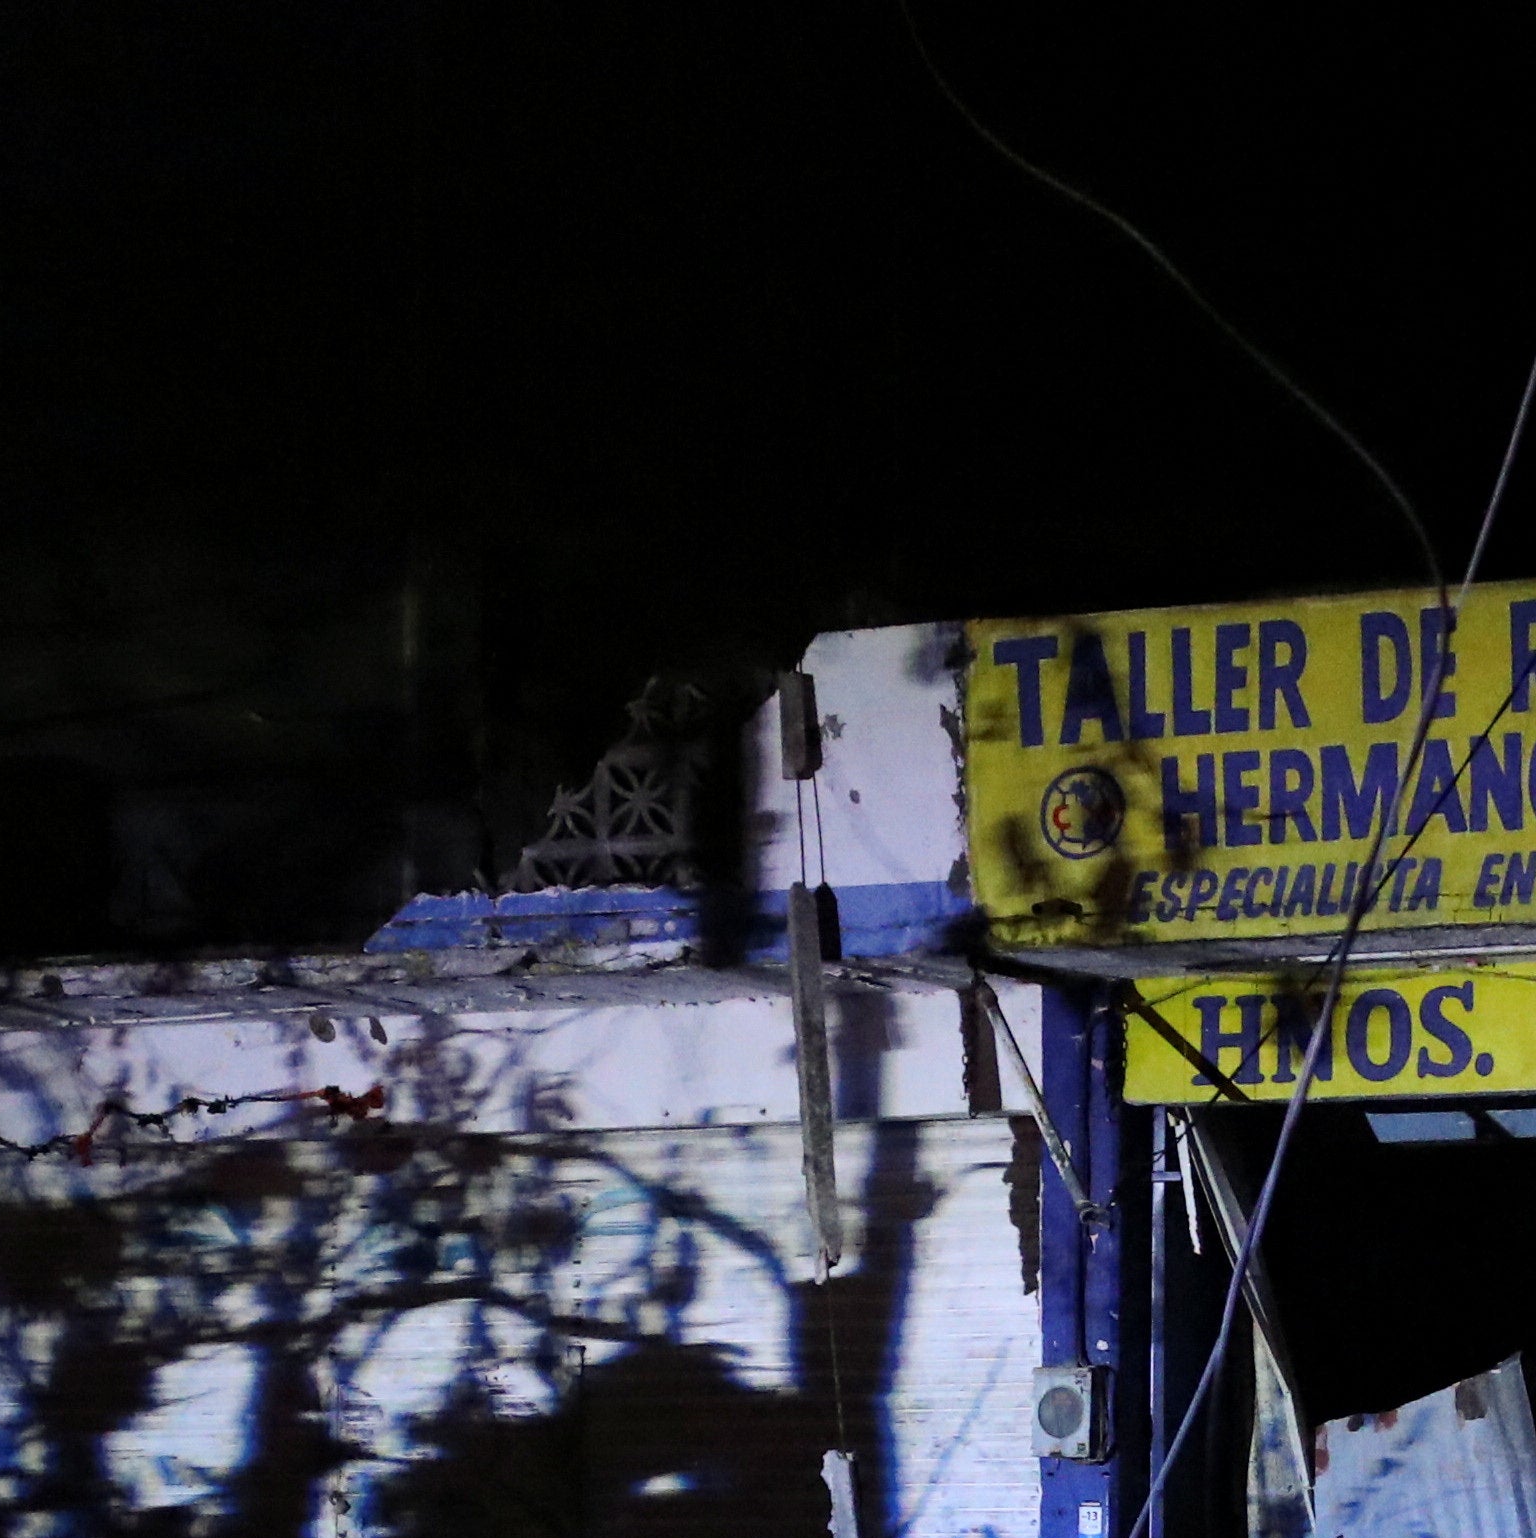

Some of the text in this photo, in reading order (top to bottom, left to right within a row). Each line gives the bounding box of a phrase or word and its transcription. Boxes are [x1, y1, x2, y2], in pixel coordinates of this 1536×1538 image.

[993, 619, 1312, 748] TALLER
[1360, 606, 1459, 725] DE
[1192, 980, 1494, 1086] HNOS.
